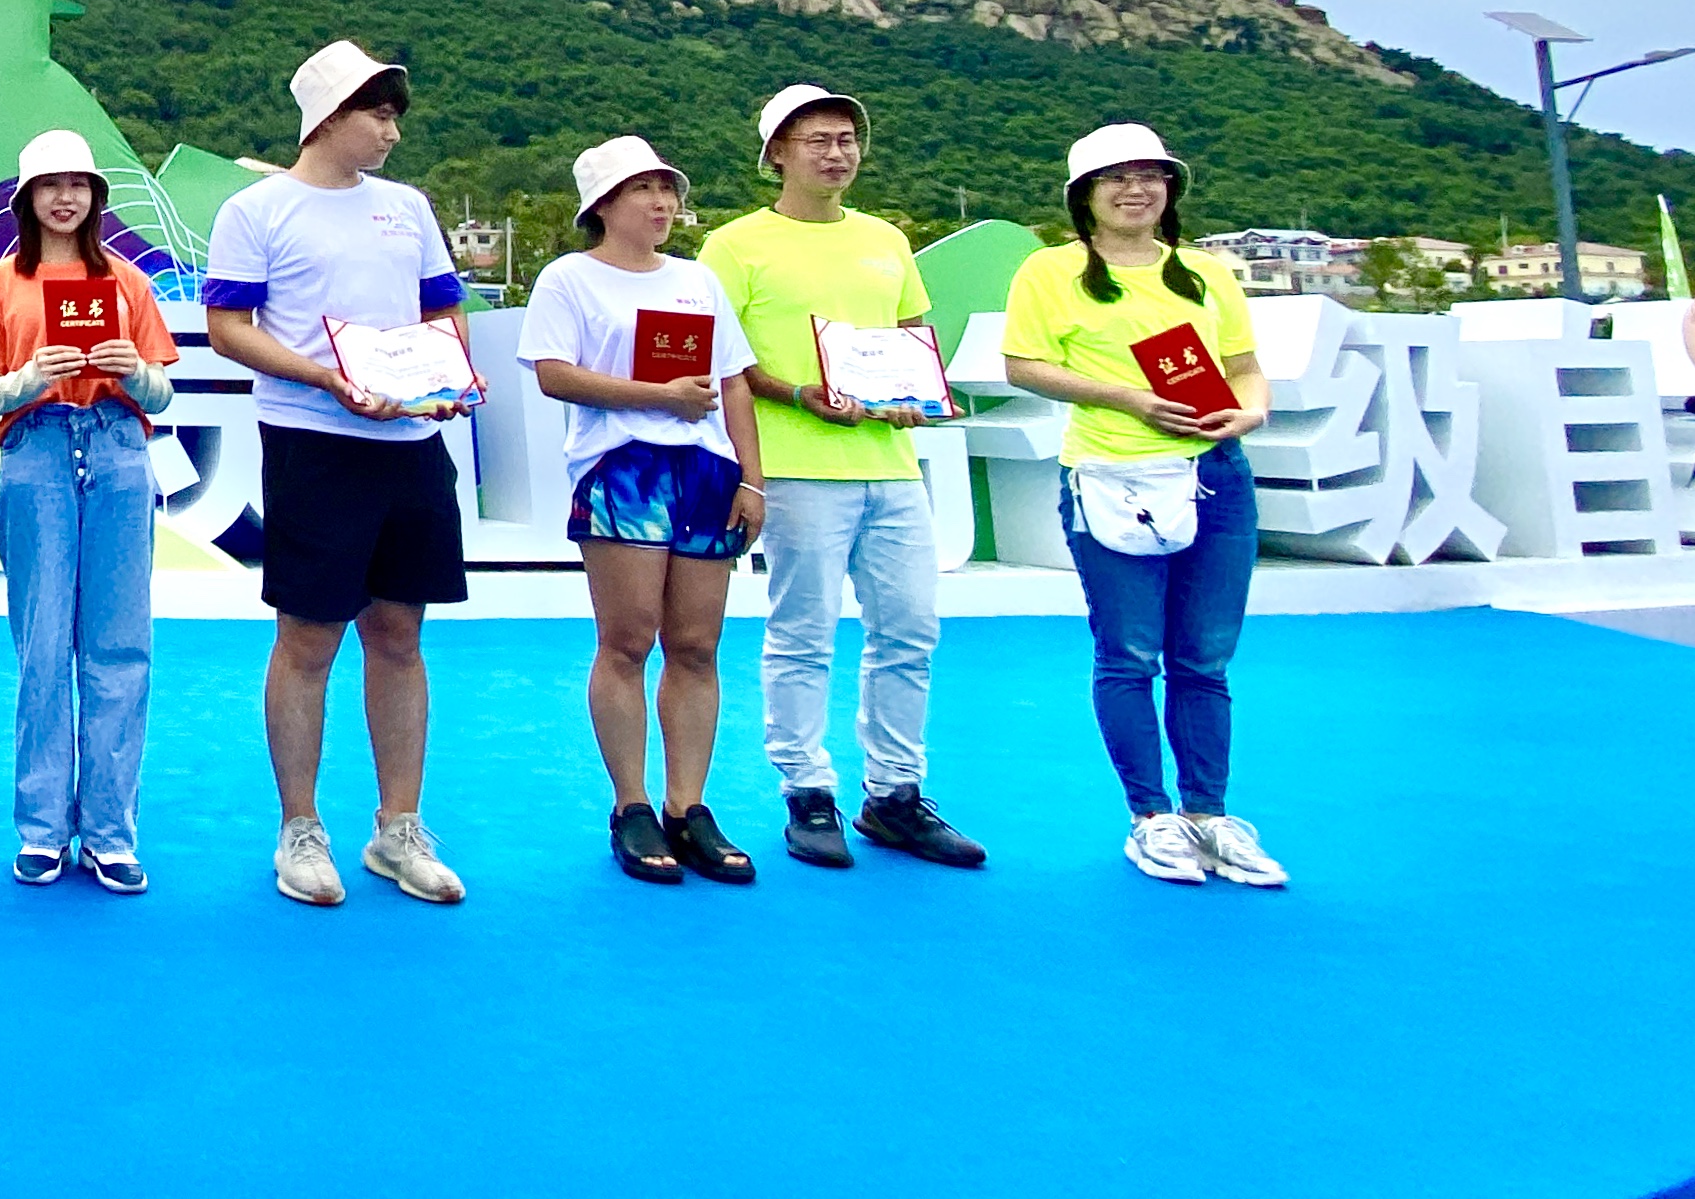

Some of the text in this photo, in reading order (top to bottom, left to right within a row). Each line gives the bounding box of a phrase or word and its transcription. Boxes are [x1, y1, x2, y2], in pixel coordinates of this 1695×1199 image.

[59, 298, 104, 318] 证书
[59, 319, 105, 328] CERTIFICATE
[653, 332, 699, 353] 证书
[1158, 346, 1199, 375] 证书
